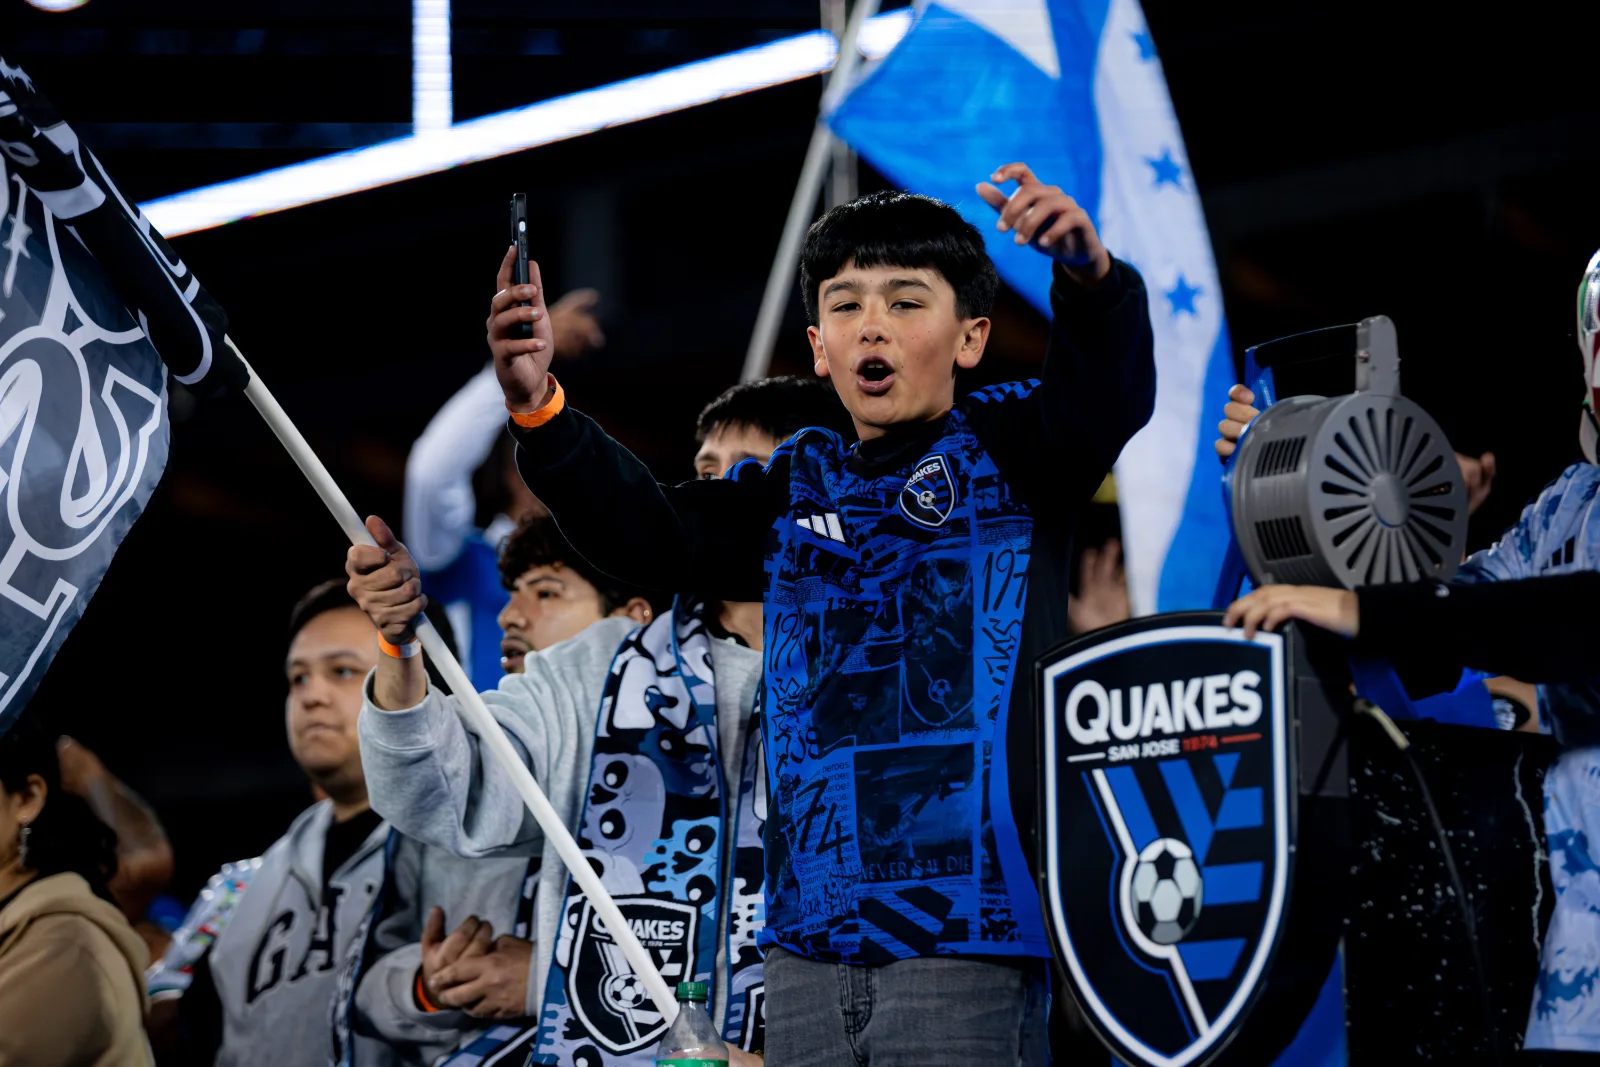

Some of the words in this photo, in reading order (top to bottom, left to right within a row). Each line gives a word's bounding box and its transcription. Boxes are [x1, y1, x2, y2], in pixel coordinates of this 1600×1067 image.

[1065, 669, 1263, 745] QUAKES
[1108, 745, 1140, 762] SAN
[1140, 738, 1180, 758] JOSE
[946, 855, 973, 872] DIE
